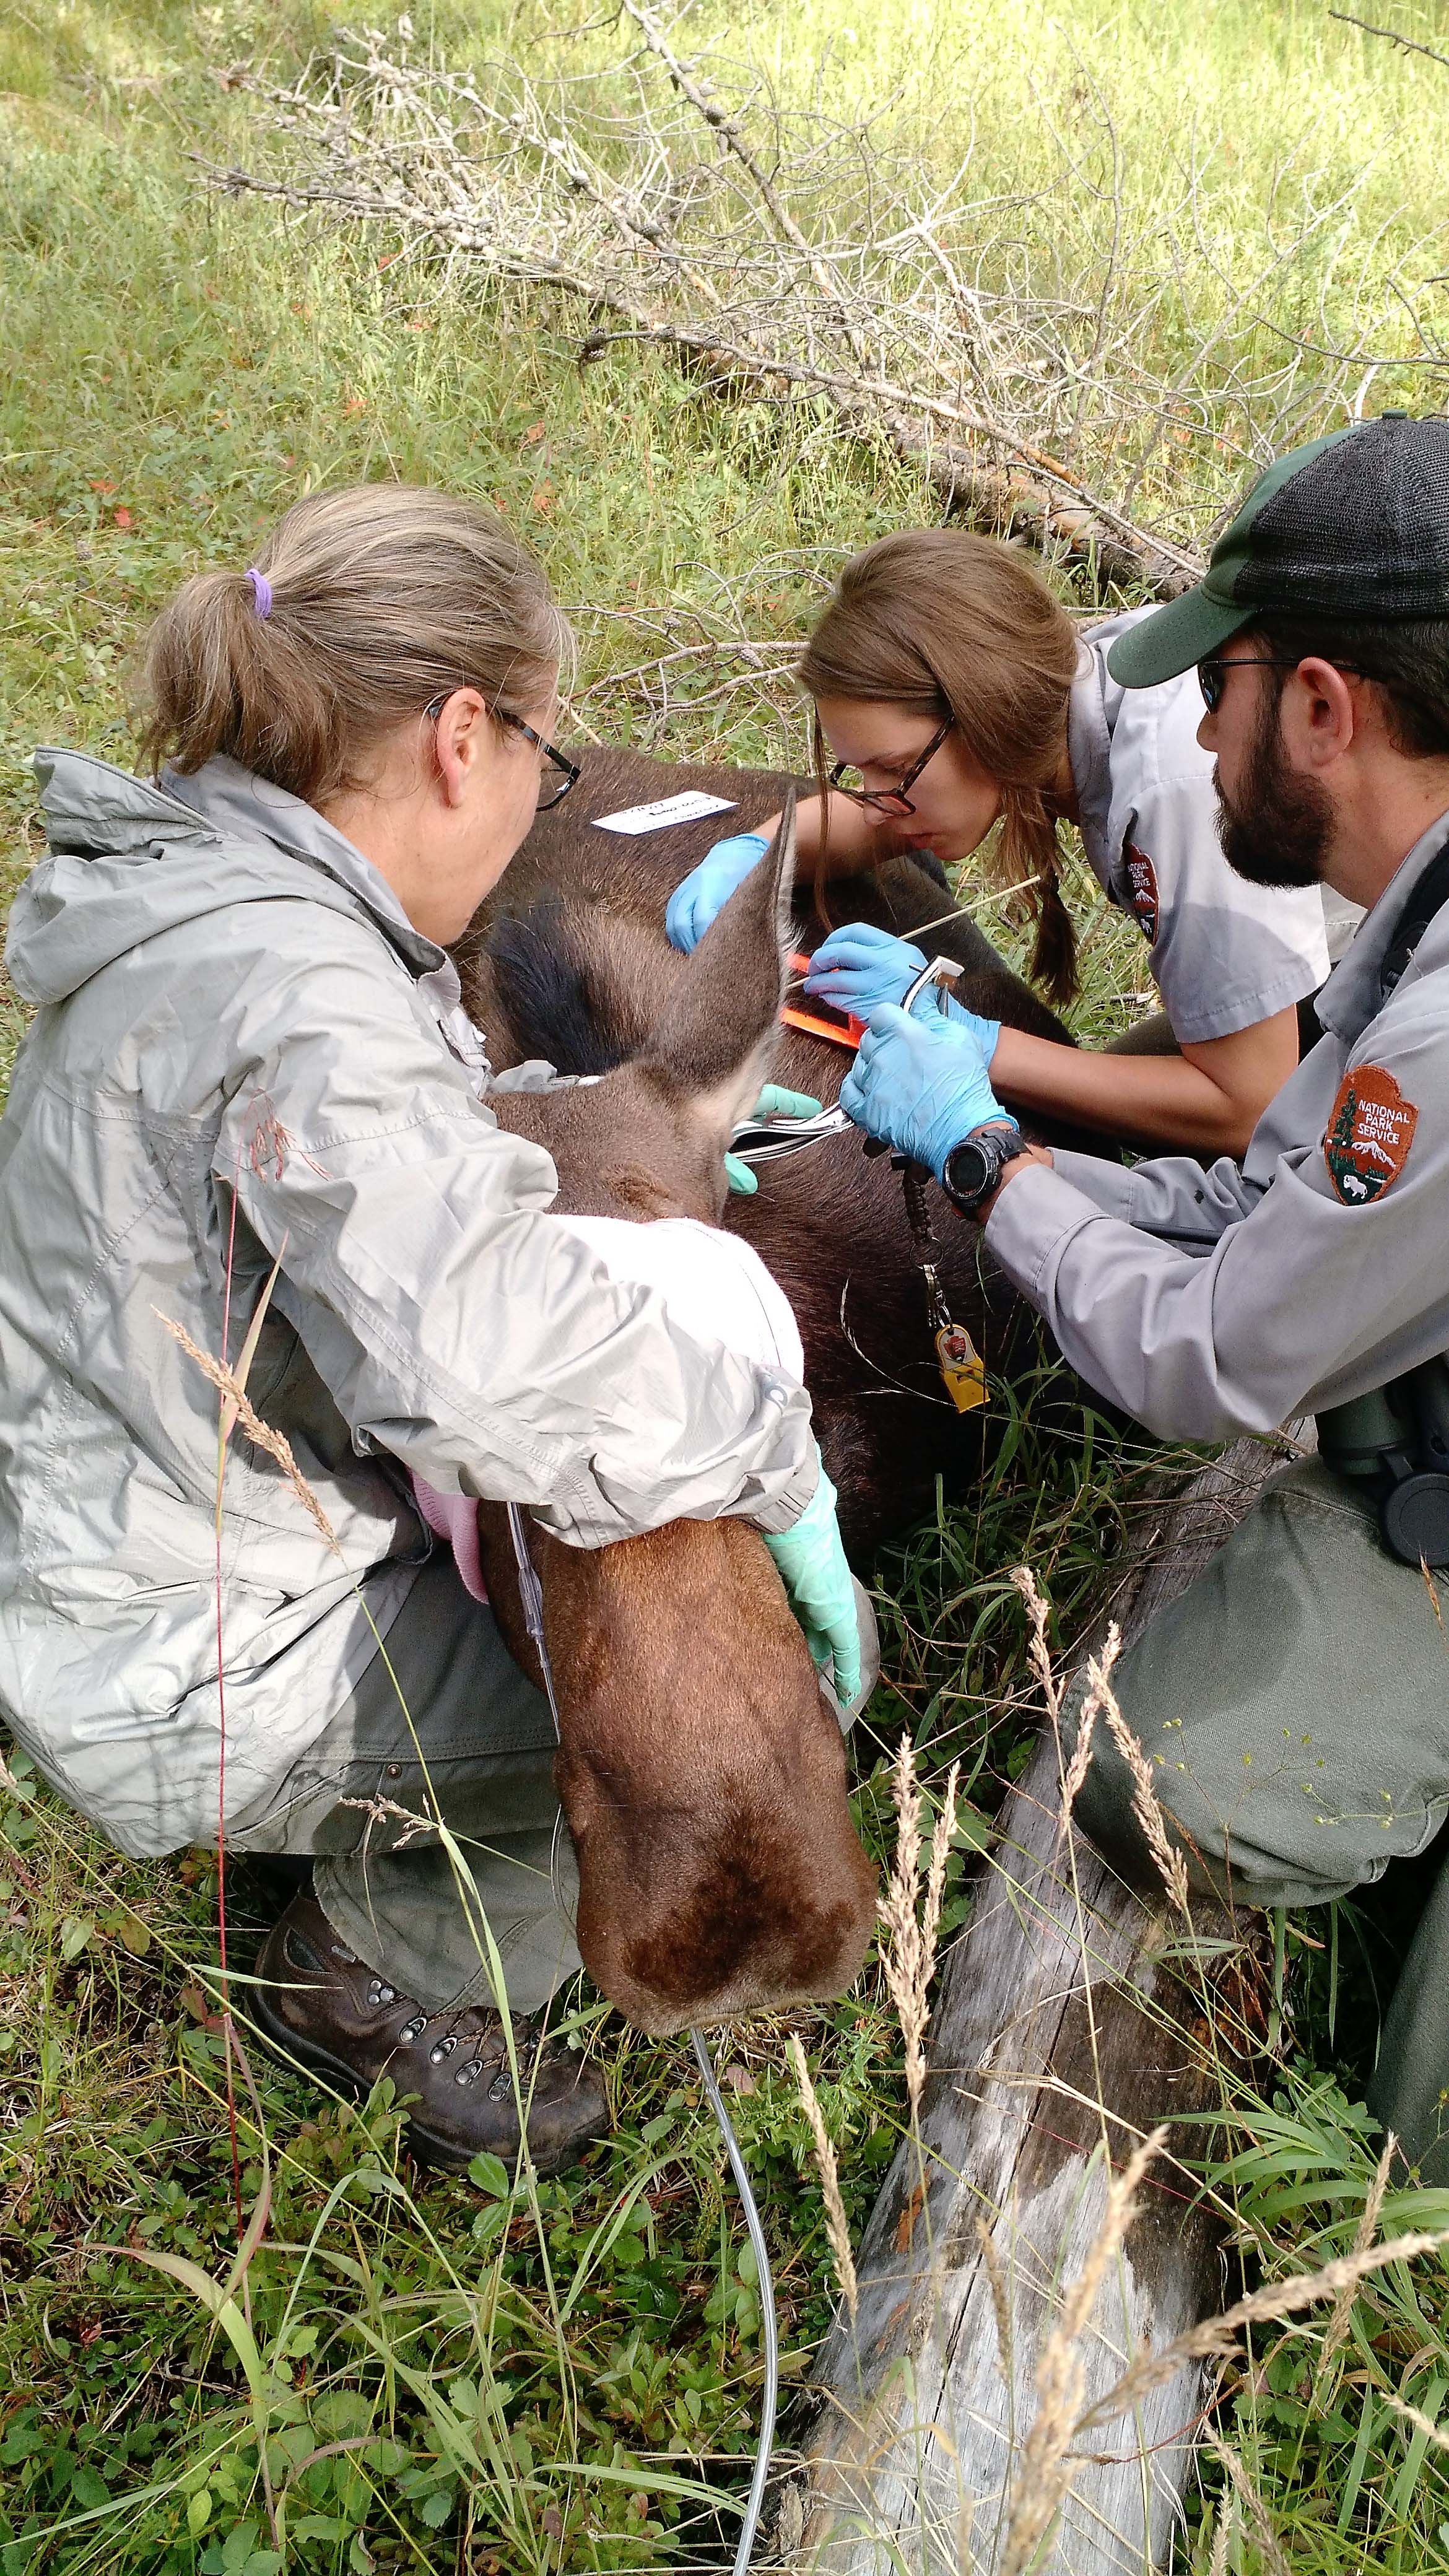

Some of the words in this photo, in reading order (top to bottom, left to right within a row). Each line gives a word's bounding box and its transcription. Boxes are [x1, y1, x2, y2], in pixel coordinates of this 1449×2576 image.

[1359, 1099, 1410, 1123] NATIONAL
[1365, 1114, 1393, 1131] PARK
[1357, 1123, 1399, 1144] SERVICE
